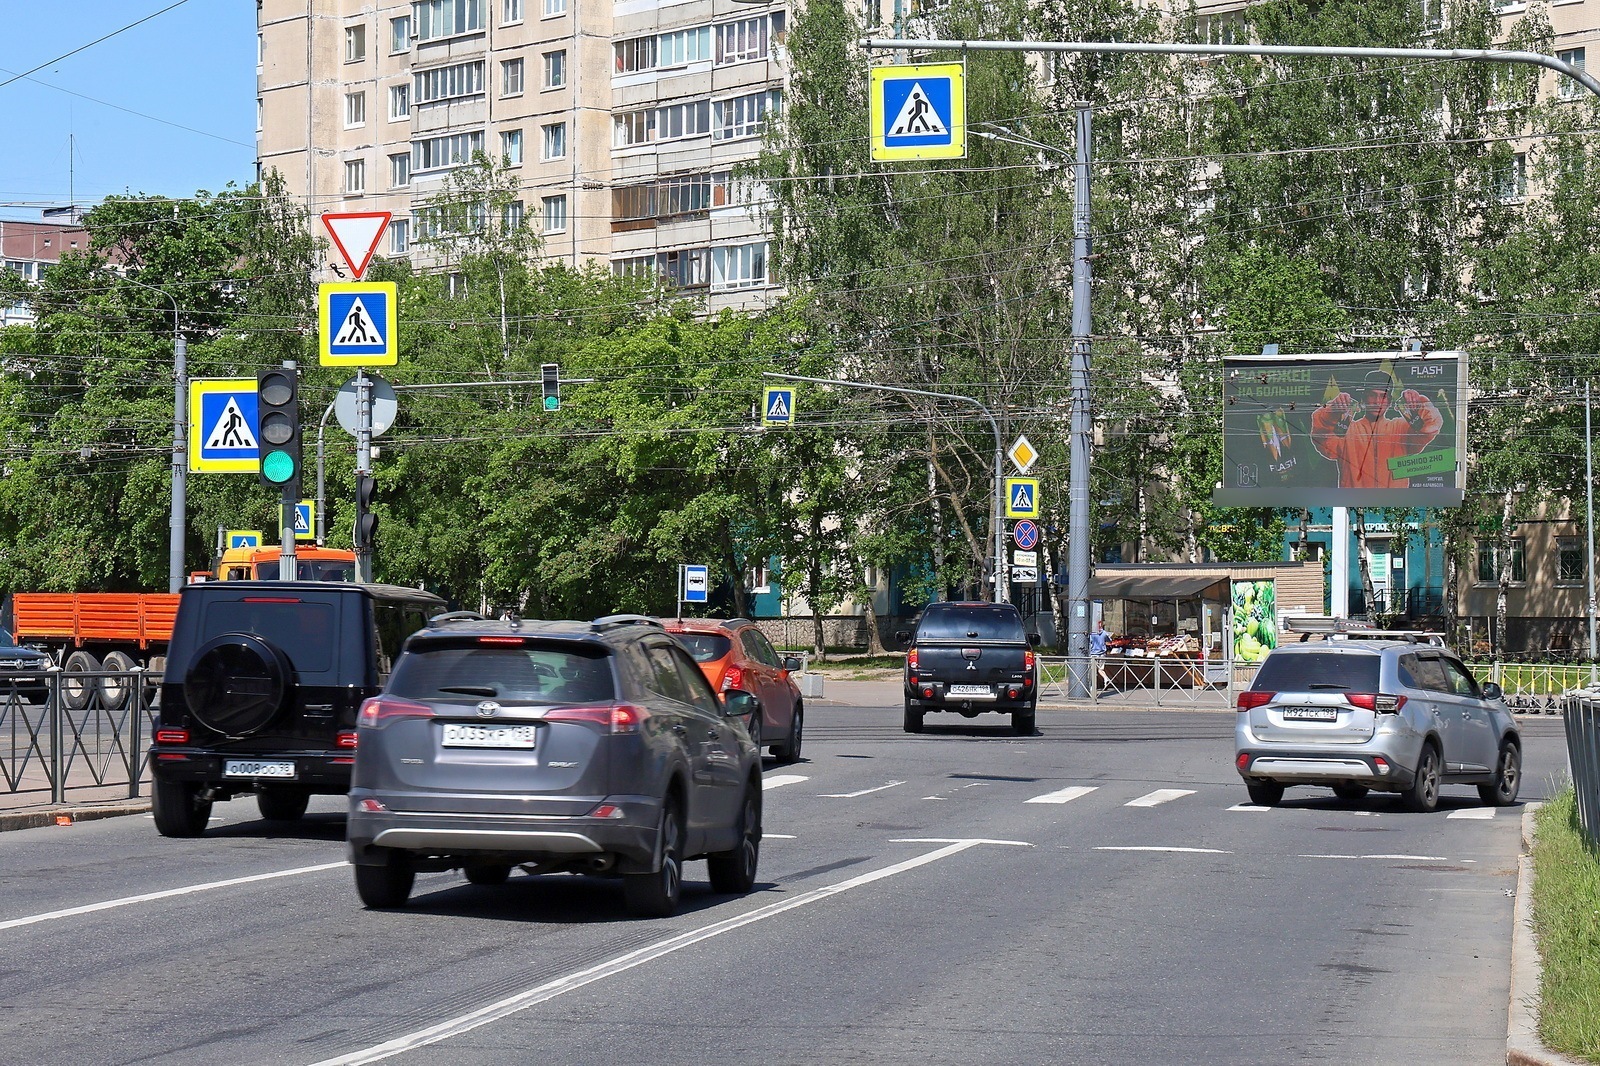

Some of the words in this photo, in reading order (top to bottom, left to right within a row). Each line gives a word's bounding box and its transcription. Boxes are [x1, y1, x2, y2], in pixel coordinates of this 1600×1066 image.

[1411, 366, 1443, 375] FLASH
[1237, 386, 1254, 397] НА
[1256, 385, 1311, 397] БОЛЬШЕЕ
[1269, 457, 1297, 472] FLASH
[1397, 457, 1428, 468] BUSHIDO
[1429, 454, 1444, 463] ZHO
[1239, 465, 1256, 485] 18+
